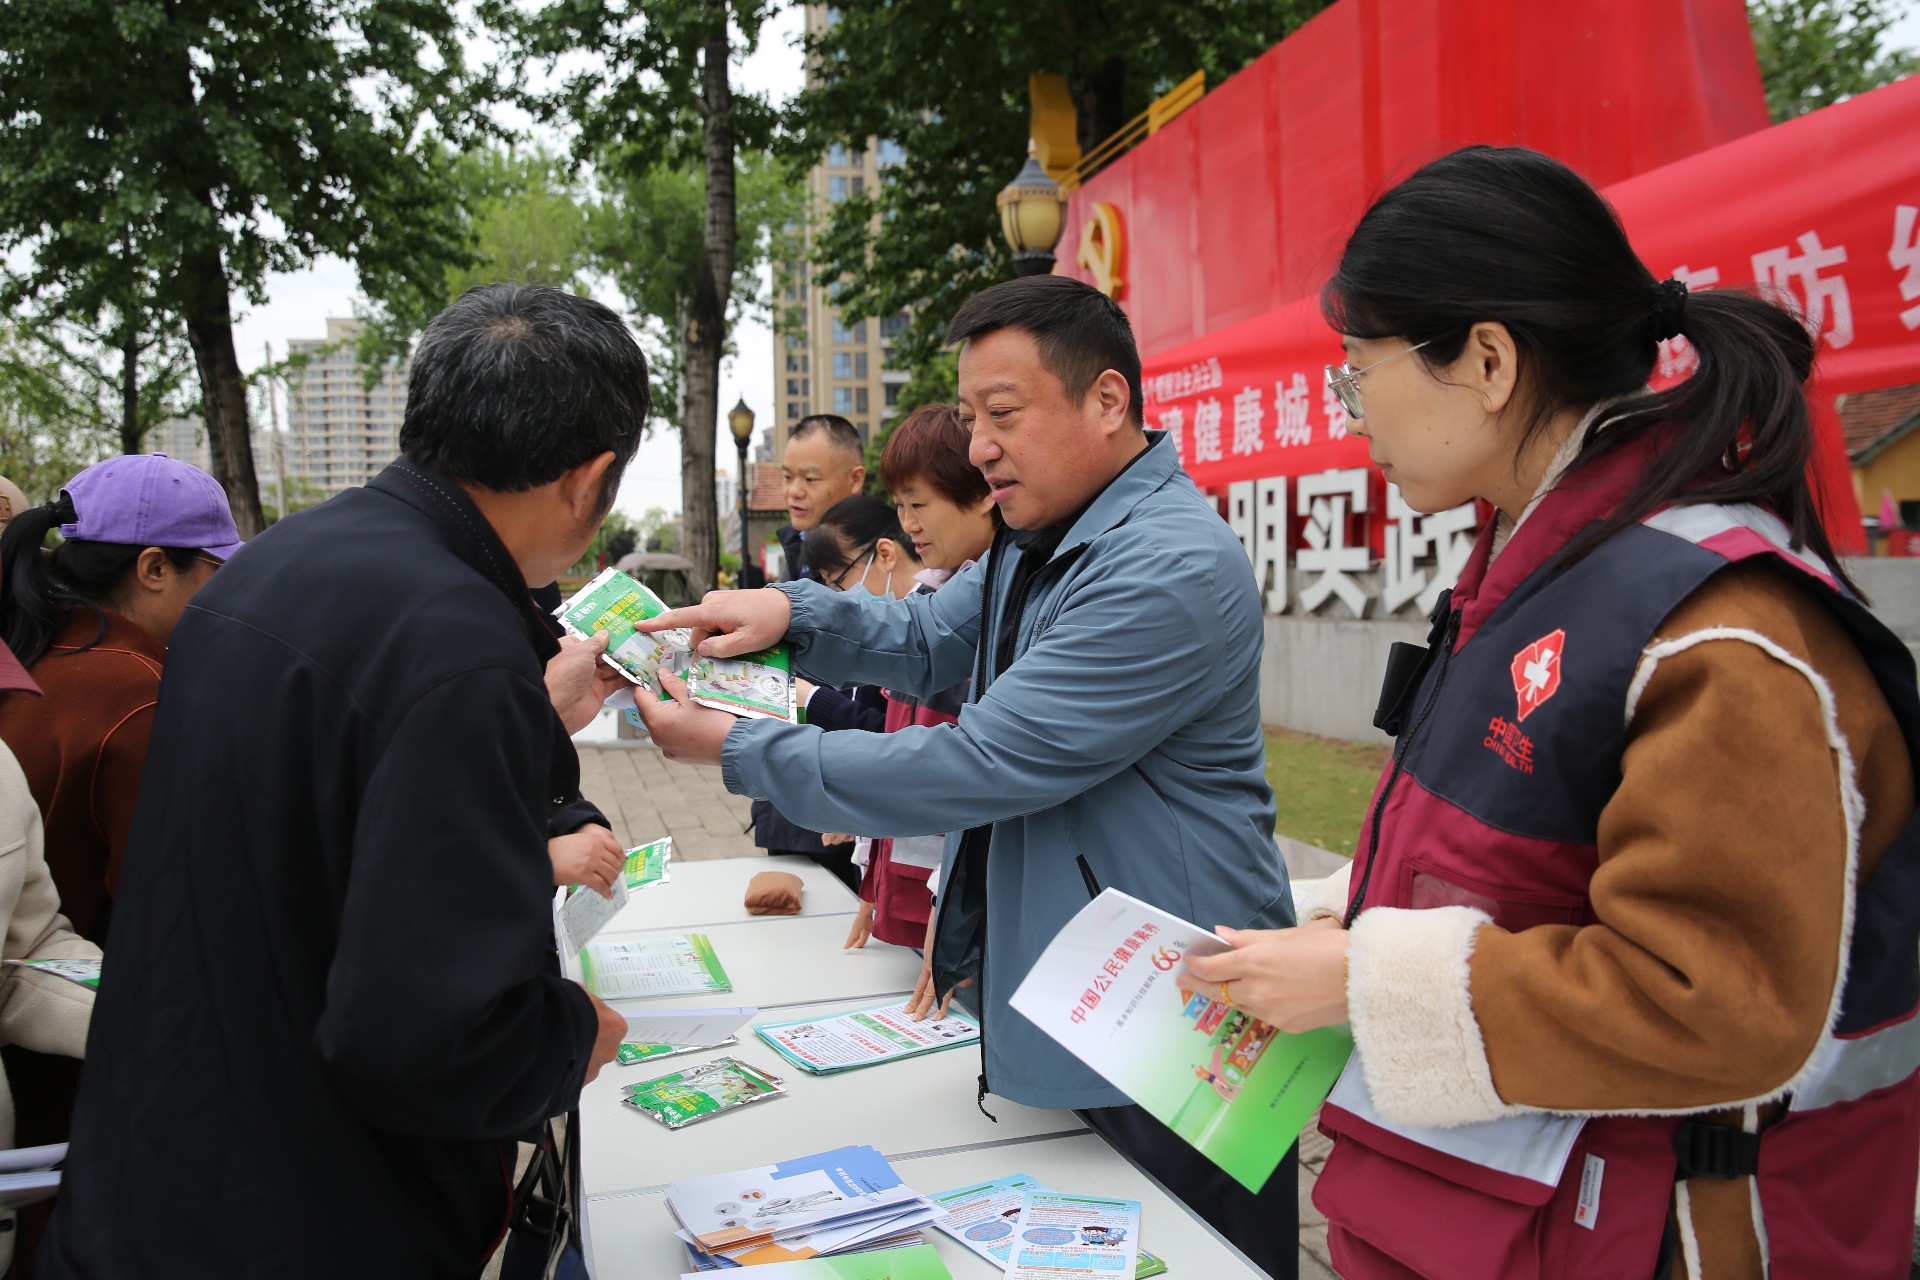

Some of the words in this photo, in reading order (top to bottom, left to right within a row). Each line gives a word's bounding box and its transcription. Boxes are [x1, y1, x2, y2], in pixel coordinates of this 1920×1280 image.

[1143, 364, 1347, 466] 建健康城
[1203, 468, 1478, 618] 明实践
[1070, 922, 1161, 1025] 中国公民健康素养
